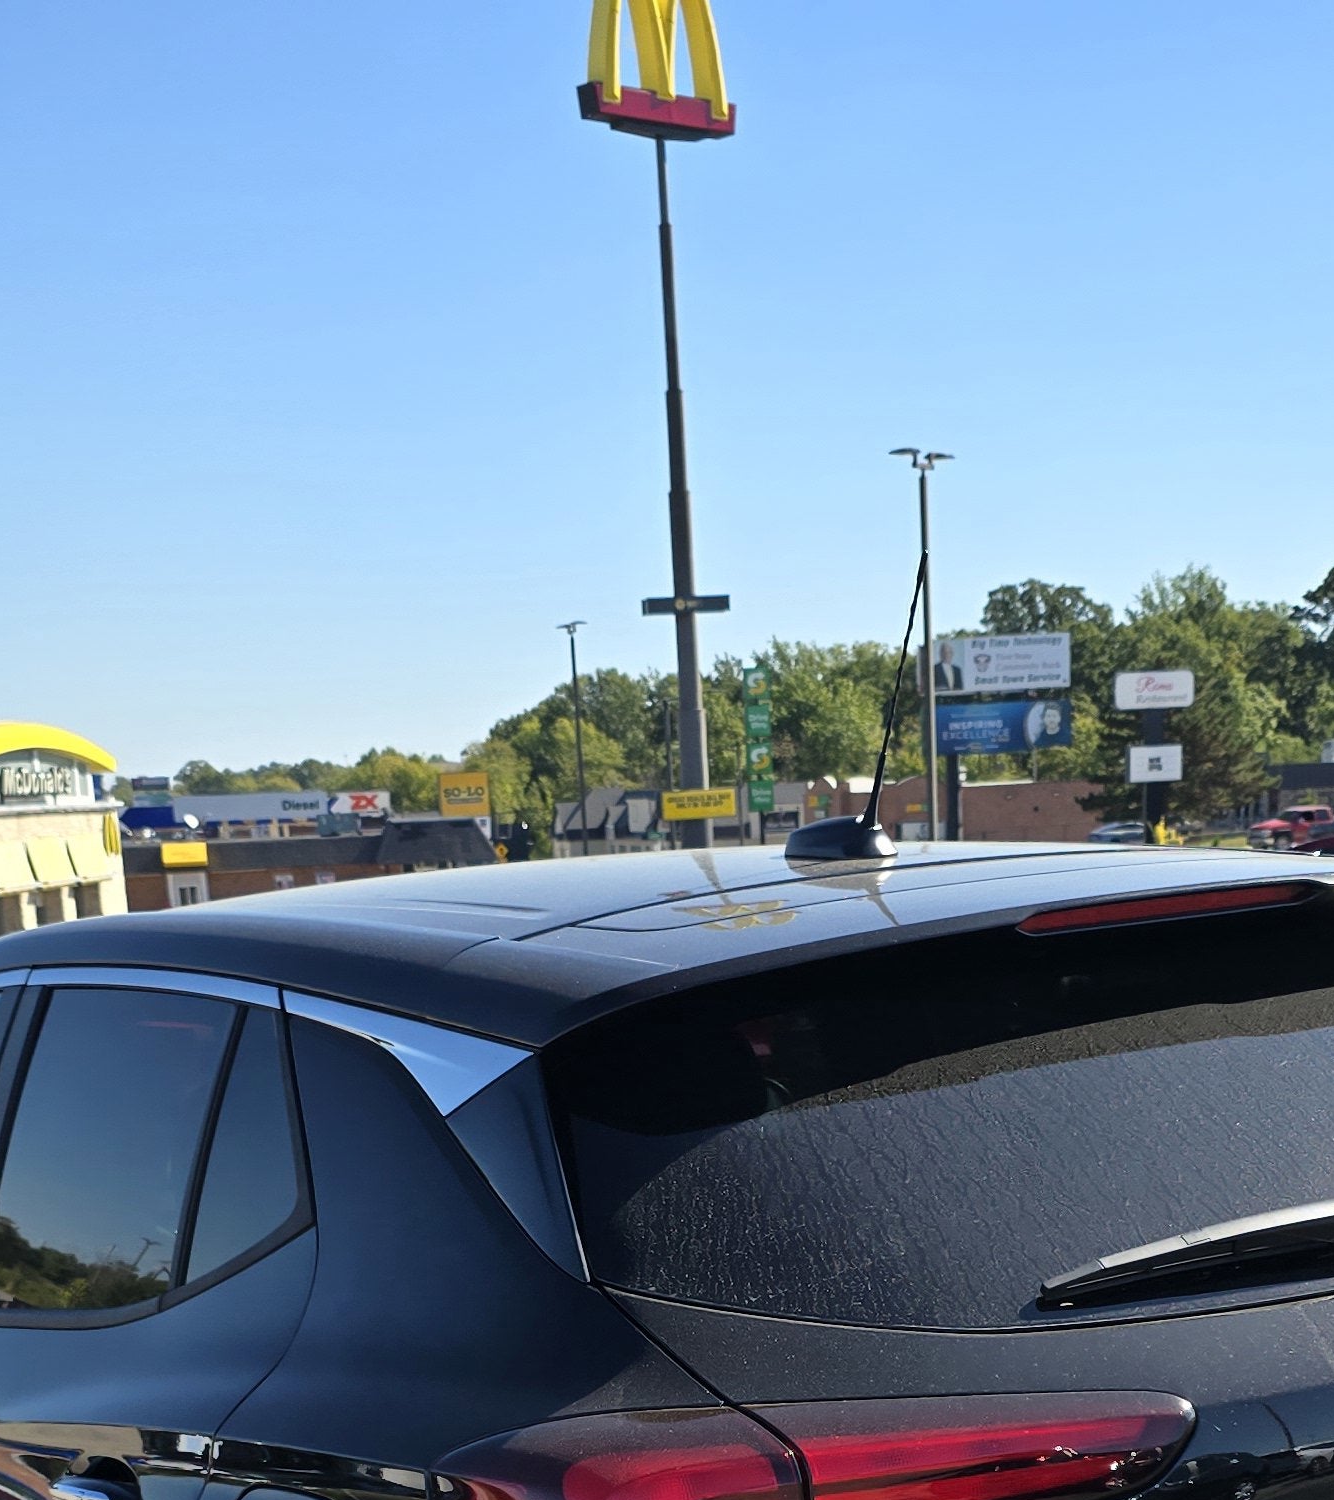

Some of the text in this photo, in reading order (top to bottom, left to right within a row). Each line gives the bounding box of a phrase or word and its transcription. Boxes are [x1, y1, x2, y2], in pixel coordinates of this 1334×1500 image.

[1013, 637, 1062, 647] Technology
[1027, 673, 1061, 682] Service
[948, 720, 1004, 731] INSPIRING
[942, 728, 1010, 741] EXCELLENCE
[2, 766, 72, 797] McDonald's
[443, 786, 484, 799] SO-LO
[282, 799, 320, 811] Diesel
